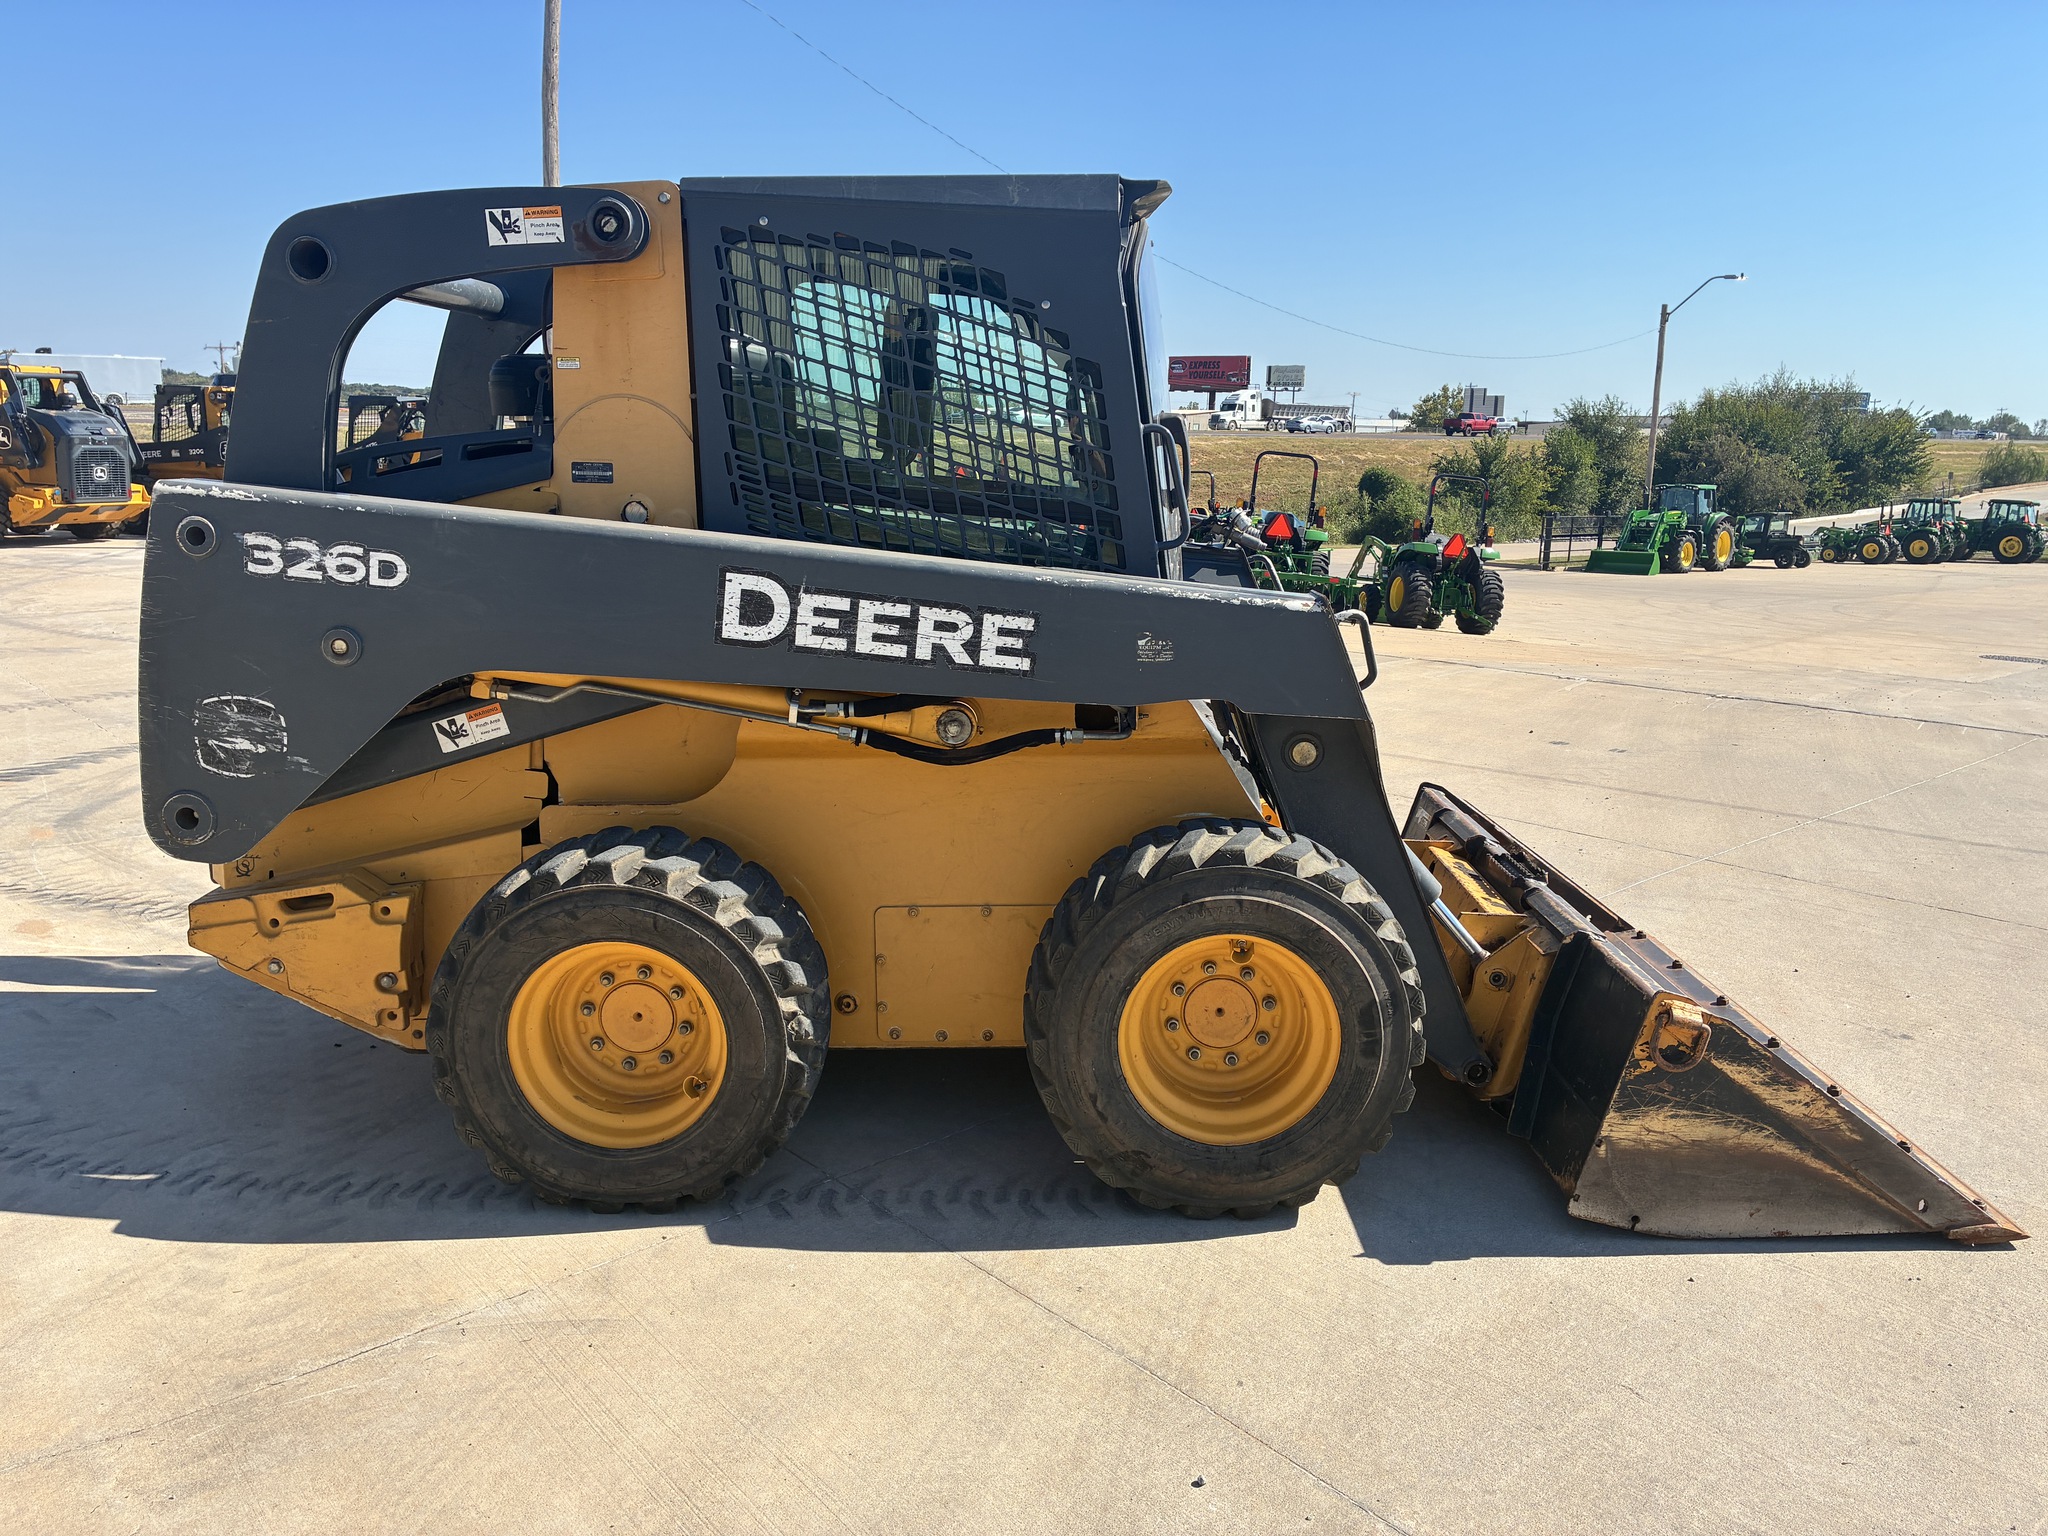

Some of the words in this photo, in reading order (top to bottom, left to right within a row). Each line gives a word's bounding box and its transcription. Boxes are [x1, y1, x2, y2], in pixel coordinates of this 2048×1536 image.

[1189, 361, 1221, 370] EXPRESS
[143, 450, 162, 458] EERE
[243, 532, 409, 588] 326D
[721, 571, 1036, 671] DEERE
[473, 706, 499, 718] WARNING
[475, 721, 489, 729] Pinch
